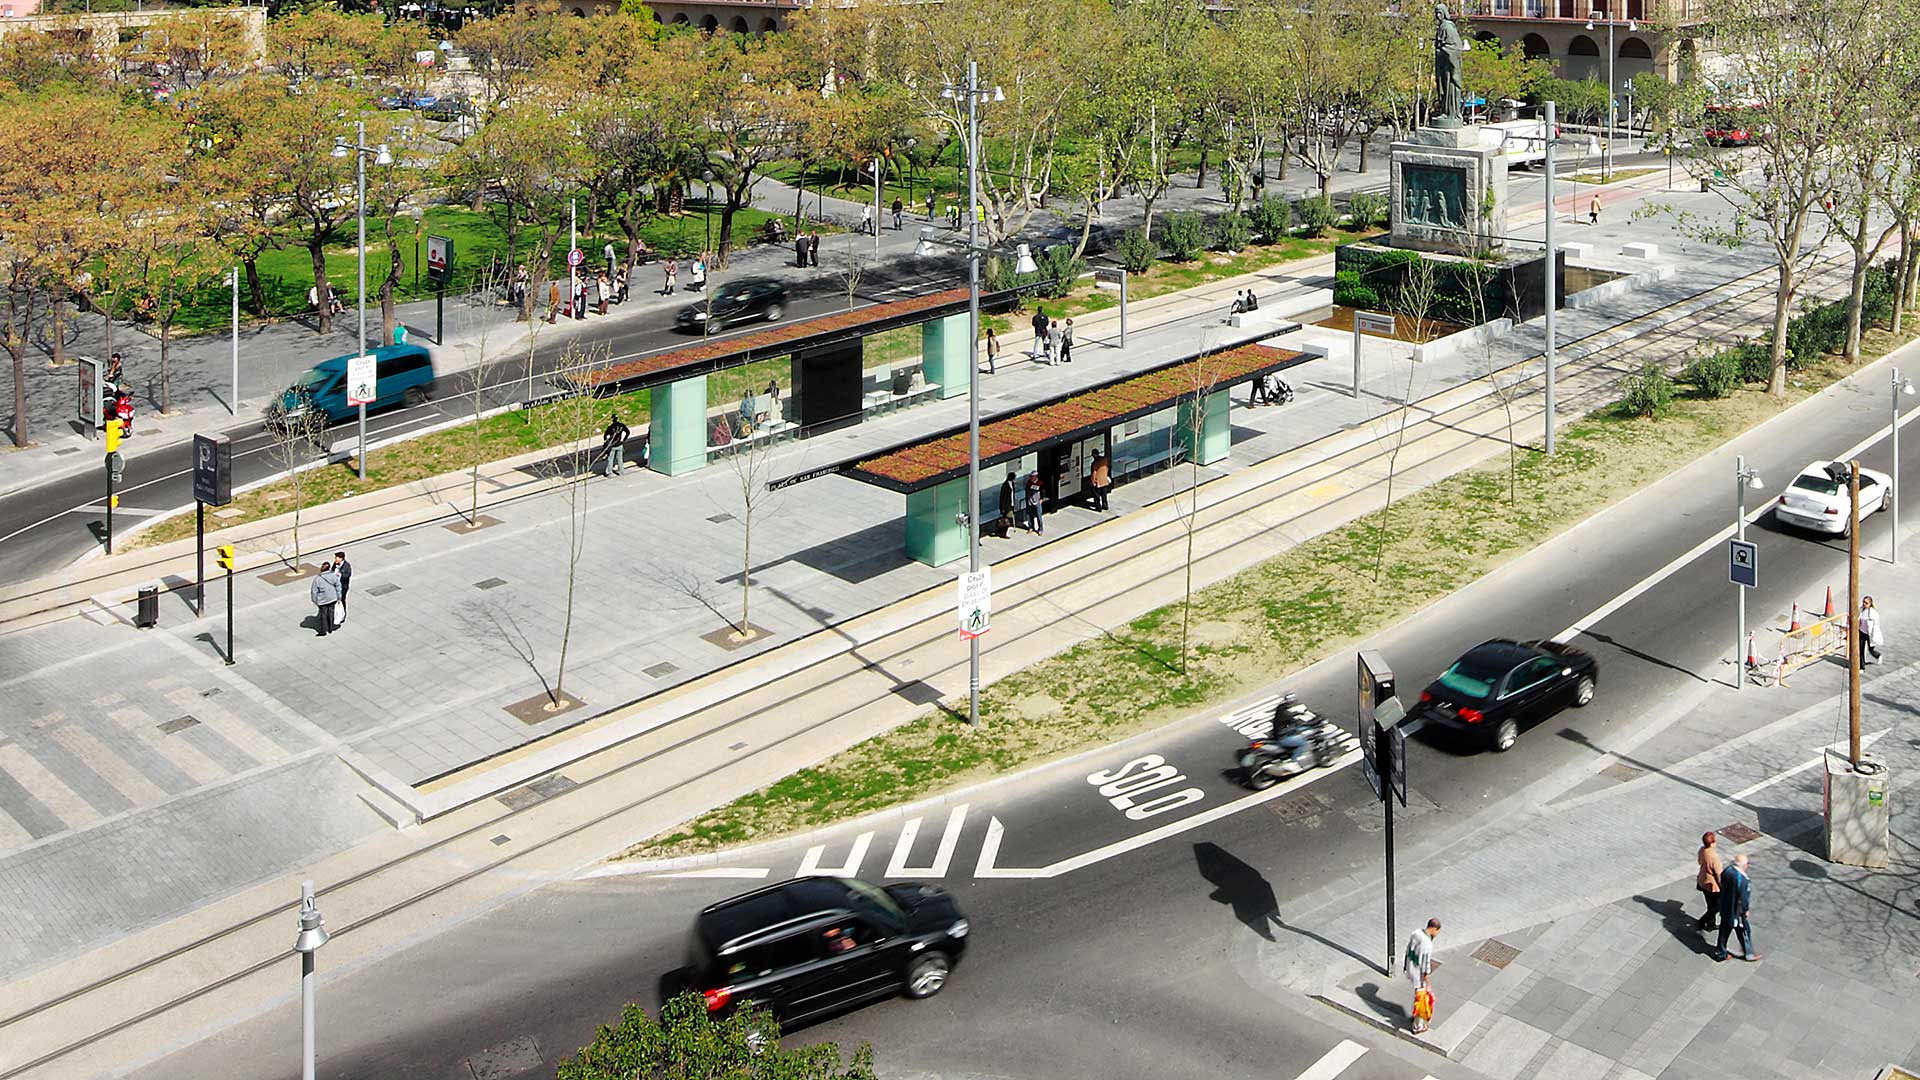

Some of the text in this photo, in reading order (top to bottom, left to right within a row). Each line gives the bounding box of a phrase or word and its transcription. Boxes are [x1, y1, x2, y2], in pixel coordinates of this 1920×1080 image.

[199, 445, 211, 470] P
[812, 466, 840, 478] FRANCISCO
[967, 573, 985, 583] Cruza
[966, 583, 979, 592] por
[1087, 754, 1205, 820] SOLO
